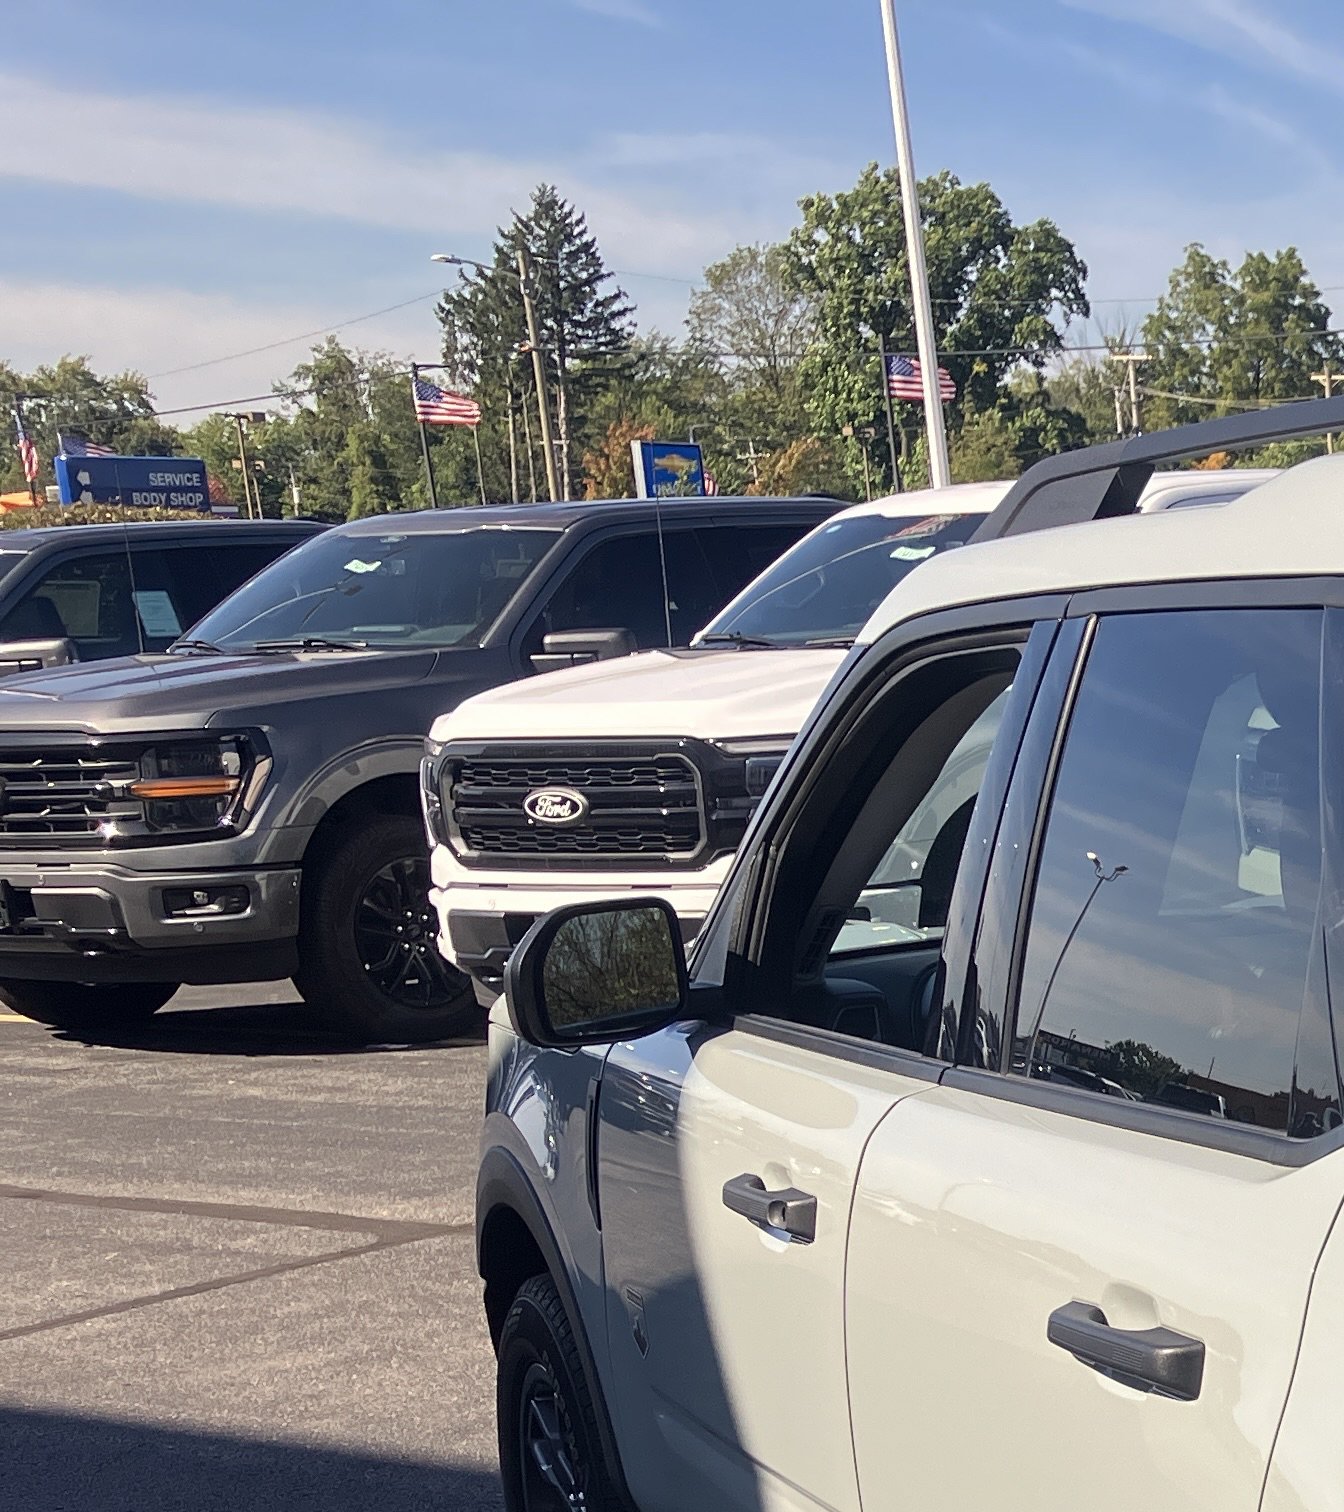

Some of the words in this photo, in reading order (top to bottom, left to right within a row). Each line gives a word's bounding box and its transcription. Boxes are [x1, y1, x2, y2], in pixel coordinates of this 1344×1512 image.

[149, 472, 202, 487] SERVICE
[132, 492, 167, 506] BODY
[169, 492, 204, 506] SHOP
[535, 795, 572, 817] Ford
